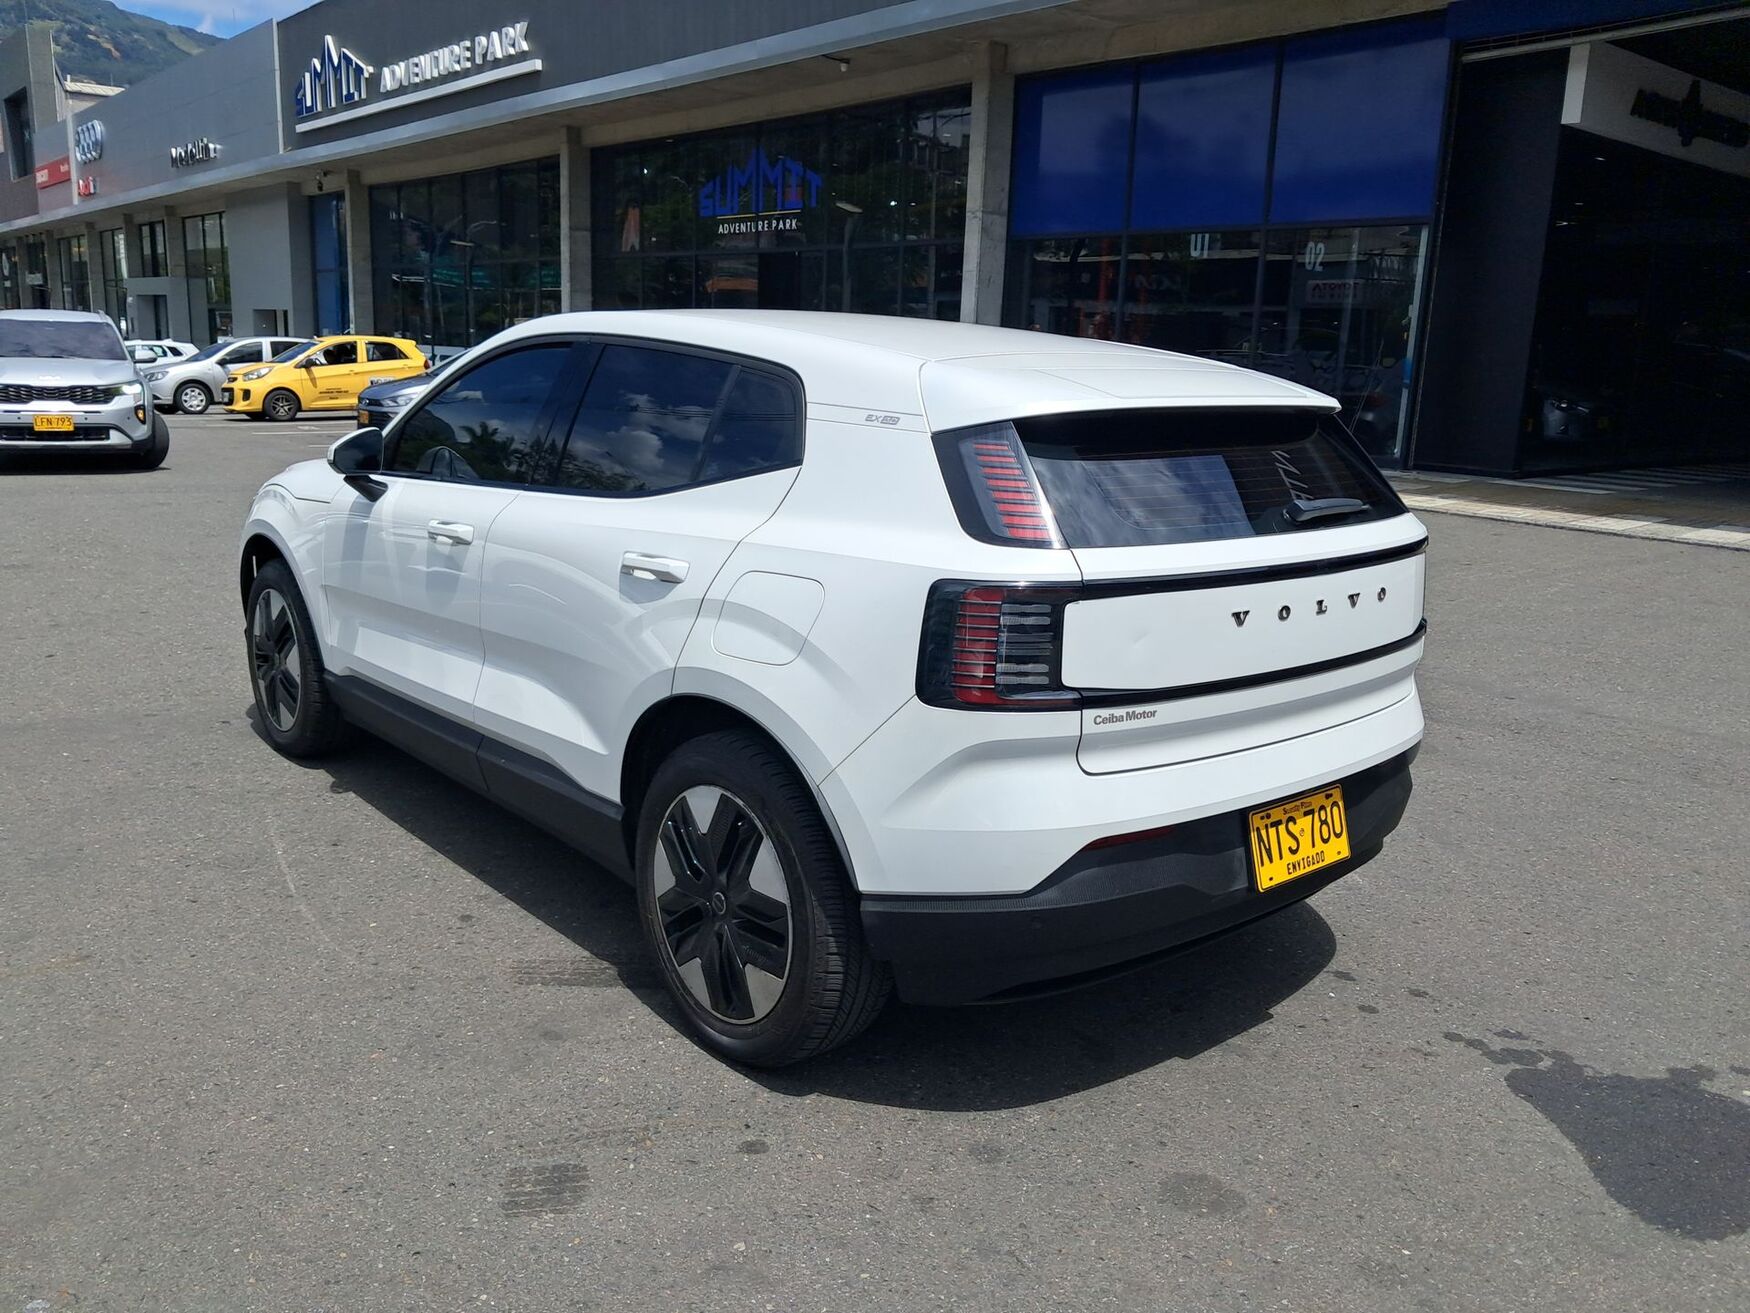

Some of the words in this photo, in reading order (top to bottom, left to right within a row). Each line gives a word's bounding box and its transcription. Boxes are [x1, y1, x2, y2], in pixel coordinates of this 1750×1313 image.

[380, 44, 471, 93] ADVENTURE
[474, 21, 529, 65] PARK
[699, 147, 823, 217] SUMMIT
[718, 221, 768, 234] ADVENTURE
[772, 218, 798, 230] PARK
[1305, 241, 1326, 272] 02
[34, 416, 53, 427] LFN
[1231, 587, 1387, 627] VOLVO
[1093, 713, 1124, 725] Ceiba
[1125, 709, 1157, 721] Motor
[1256, 815, 1300, 867] NTS
[1303, 801, 1344, 848] 780
[1286, 850, 1326, 875] ENVIGADO
